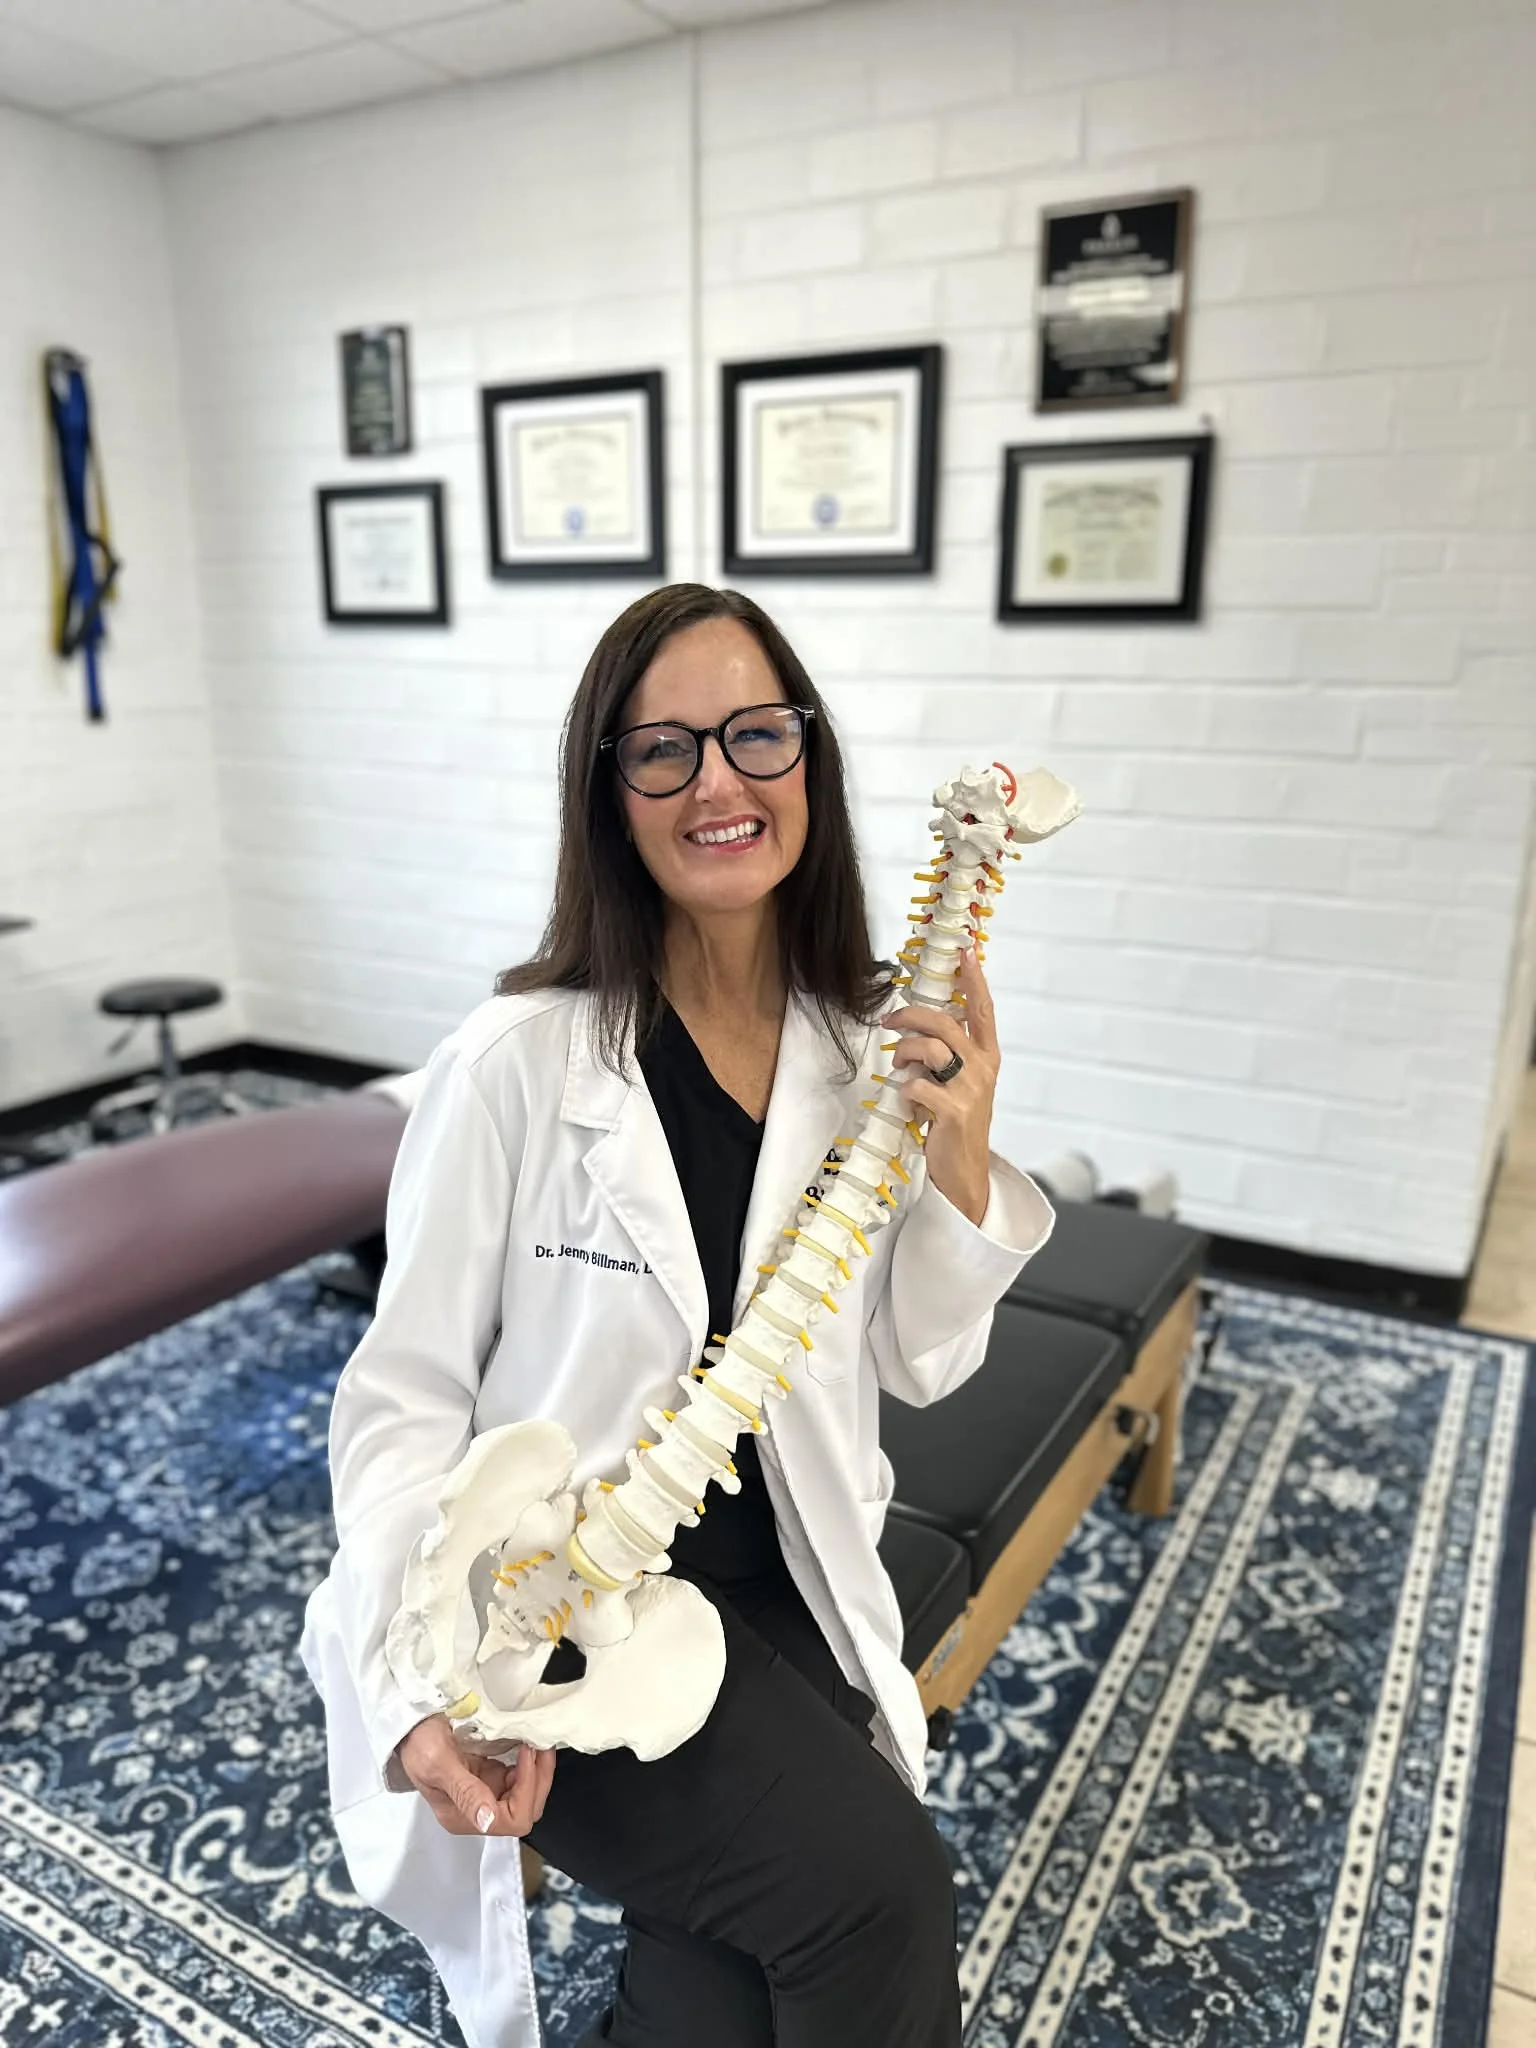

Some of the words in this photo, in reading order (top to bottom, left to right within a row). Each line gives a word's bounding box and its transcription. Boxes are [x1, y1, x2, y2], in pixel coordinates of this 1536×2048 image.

[535, 1245, 554, 1258] Dr.
[558, 1244, 590, 1264] Jenny
[591, 1252, 640, 1275] Billman,
